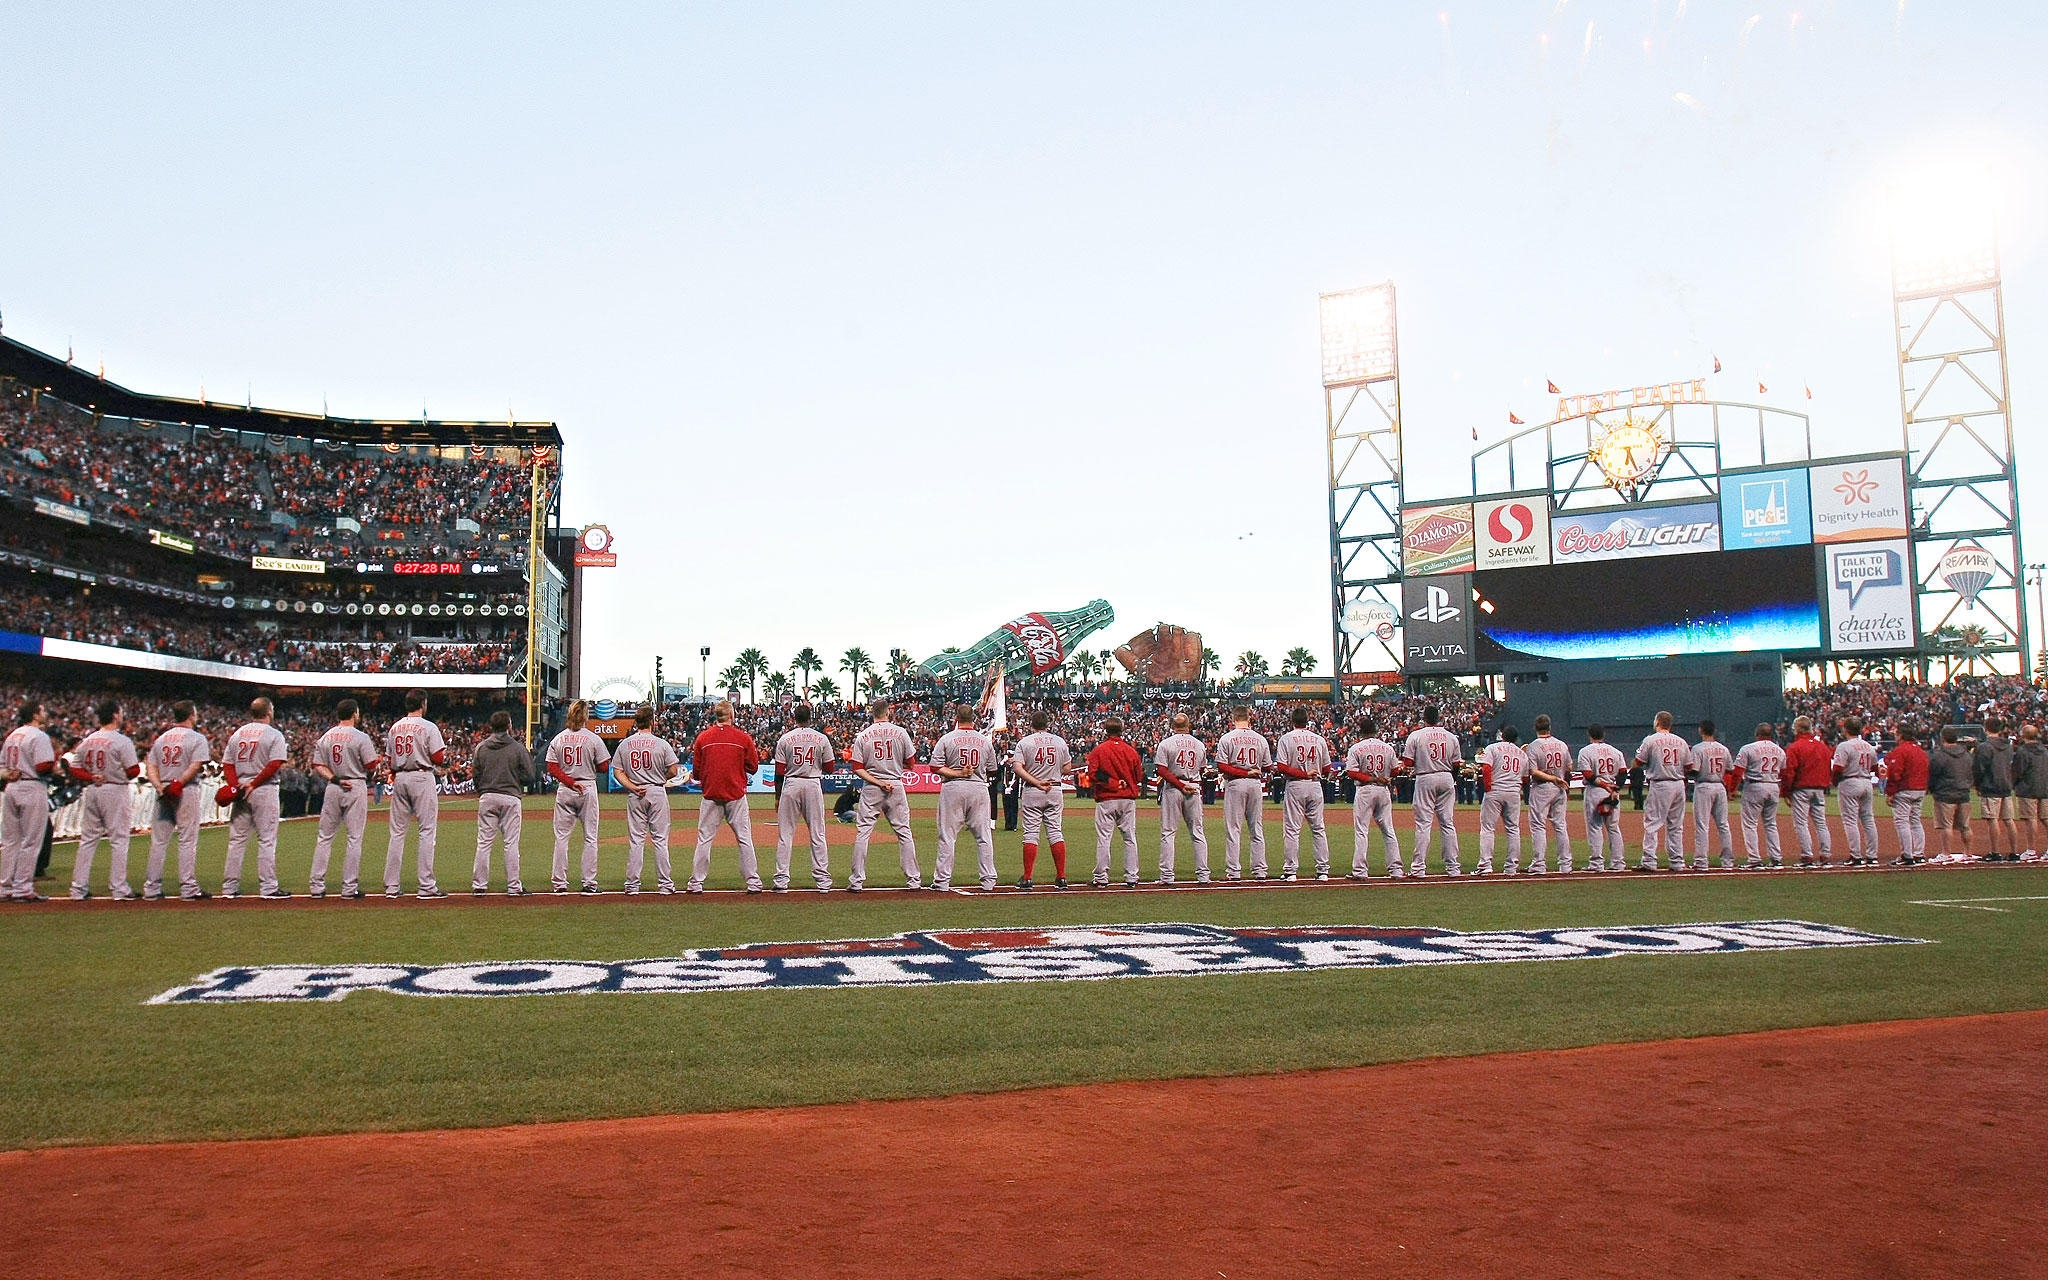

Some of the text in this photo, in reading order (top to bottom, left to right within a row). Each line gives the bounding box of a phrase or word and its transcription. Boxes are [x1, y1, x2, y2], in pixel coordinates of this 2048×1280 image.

[1555, 378, 1706, 422] AT&T PARK
[1745, 506, 1785, 525] PG&E
[1818, 507, 1898, 524] Dignity Health
[1408, 521, 1468, 548] DIAMOND
[1557, 522, 1713, 554] Coors LIGHT
[1488, 545, 1536, 558] SAFEWAY
[255, 558, 321, 572] See's CANDIES
[393, 563, 461, 574] 6:27:28 PM
[1423, 554, 1473, 571] Culinary Walnuts
[1485, 557, 1519, 566] Ingredients
[1841, 556, 1882, 567] TALK TO
[1945, 554, 1989, 569] RE/MAX
[1841, 566, 1883, 578] CHUCK
[1346, 609, 1392, 626] salesforce
[1838, 613, 1904, 631] charles
[1838, 630, 1906, 643] SCHWAB
[594, 724, 618, 734] at&t
[162, 745, 182, 766] 32
[238, 741, 259, 762] 27
[332, 744, 343, 766] 6
[563, 746, 583, 766] 61
[793, 746, 815, 766] 54
[873, 739, 893, 760] 51
[959, 748, 980, 768] 50
[1034, 746, 1056, 766] 45
[1236, 747, 1258, 766] 40
[1297, 745, 1316, 763] 34
[1429, 742, 1447, 760] 31
[1663, 748, 1679, 766] 21
[629, 750, 652, 771] 60
[1175, 749, 1196, 769] 43
[1366, 754, 1385, 773] 33
[1502, 755, 1520, 774] 30
[1546, 752, 1562, 769] 28
[1598, 757, 1614, 775] 26
[1708, 757, 1723, 774] 15
[1761, 756, 1779, 773] 22
[140, 920, 1938, 1004] POSTSEASON
